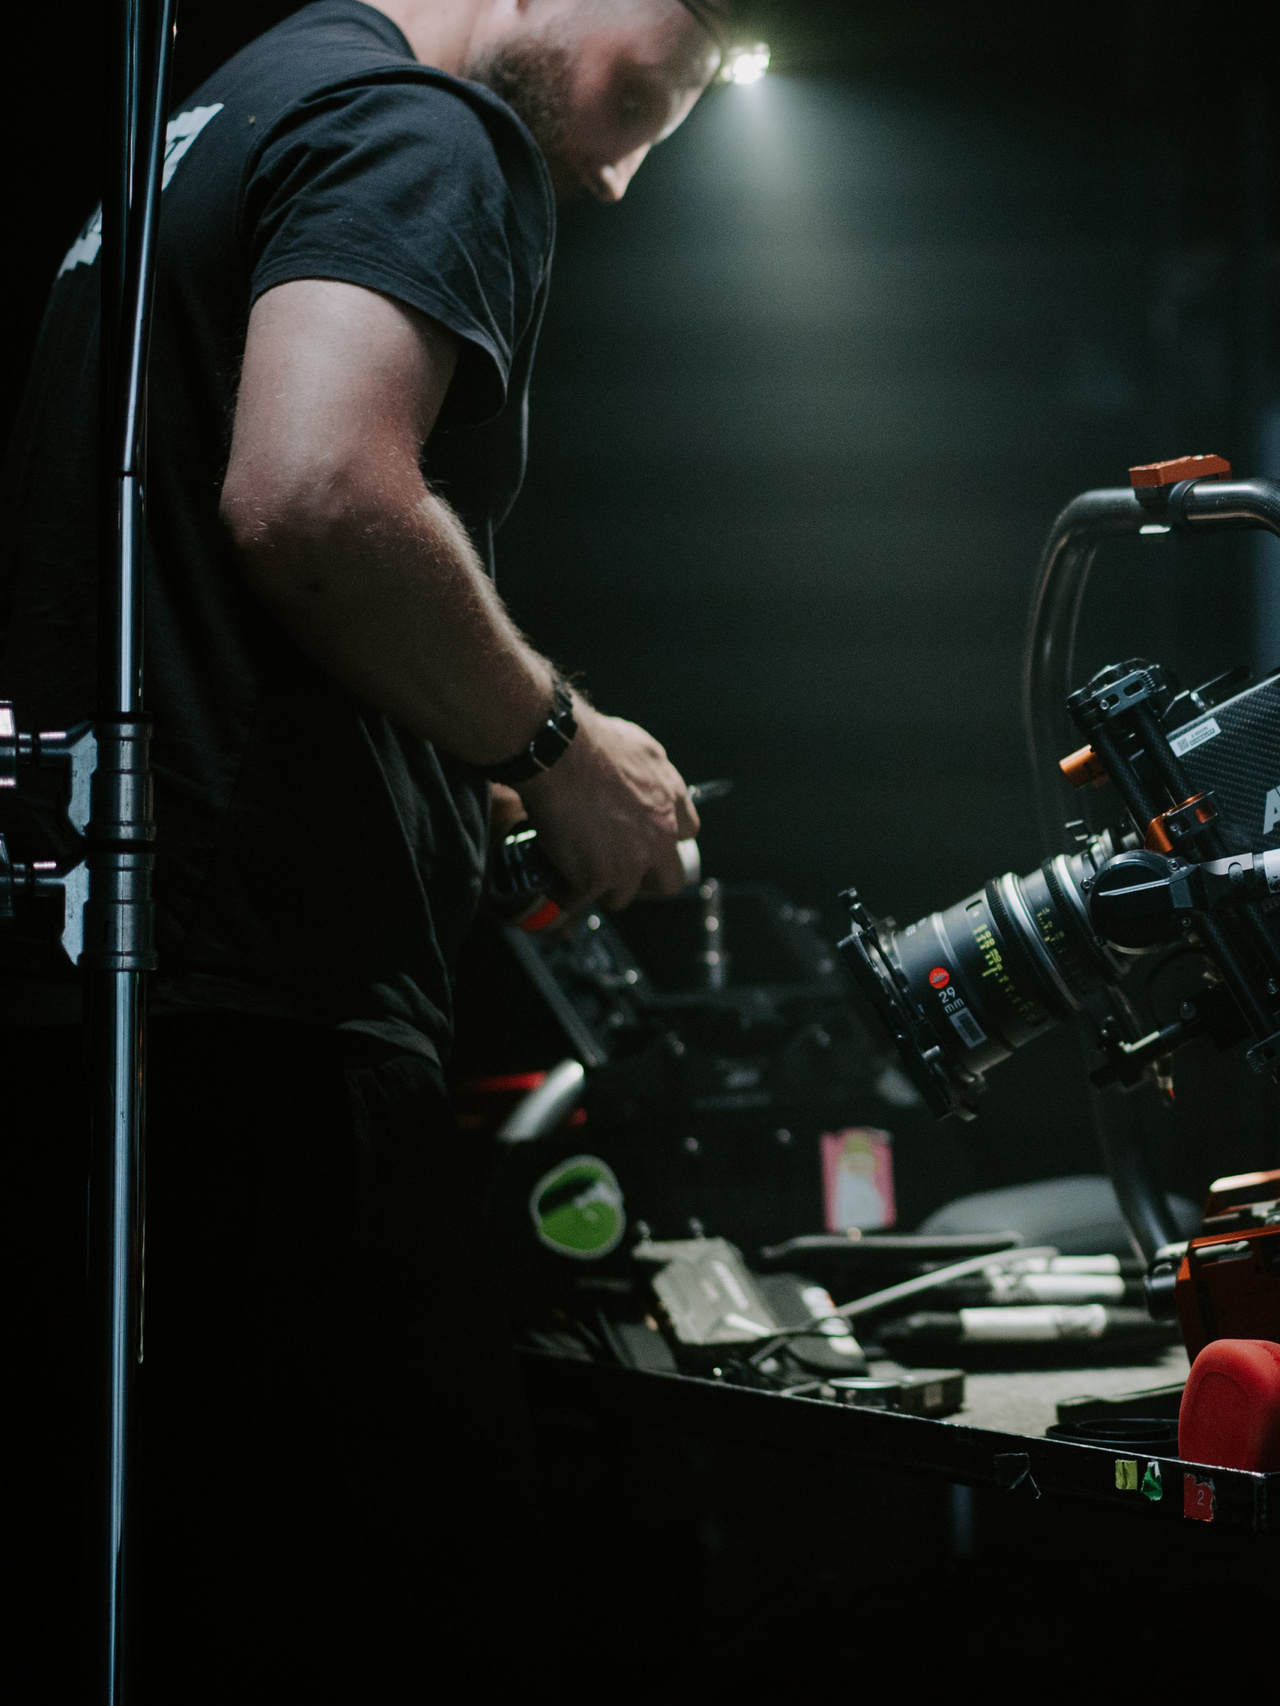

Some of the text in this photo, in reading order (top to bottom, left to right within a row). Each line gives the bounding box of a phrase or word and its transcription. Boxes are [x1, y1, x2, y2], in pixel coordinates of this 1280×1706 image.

[938, 986, 956, 1003] 29
[944, 998, 965, 1014] mm
[1197, 1489, 1205, 1506] 2
